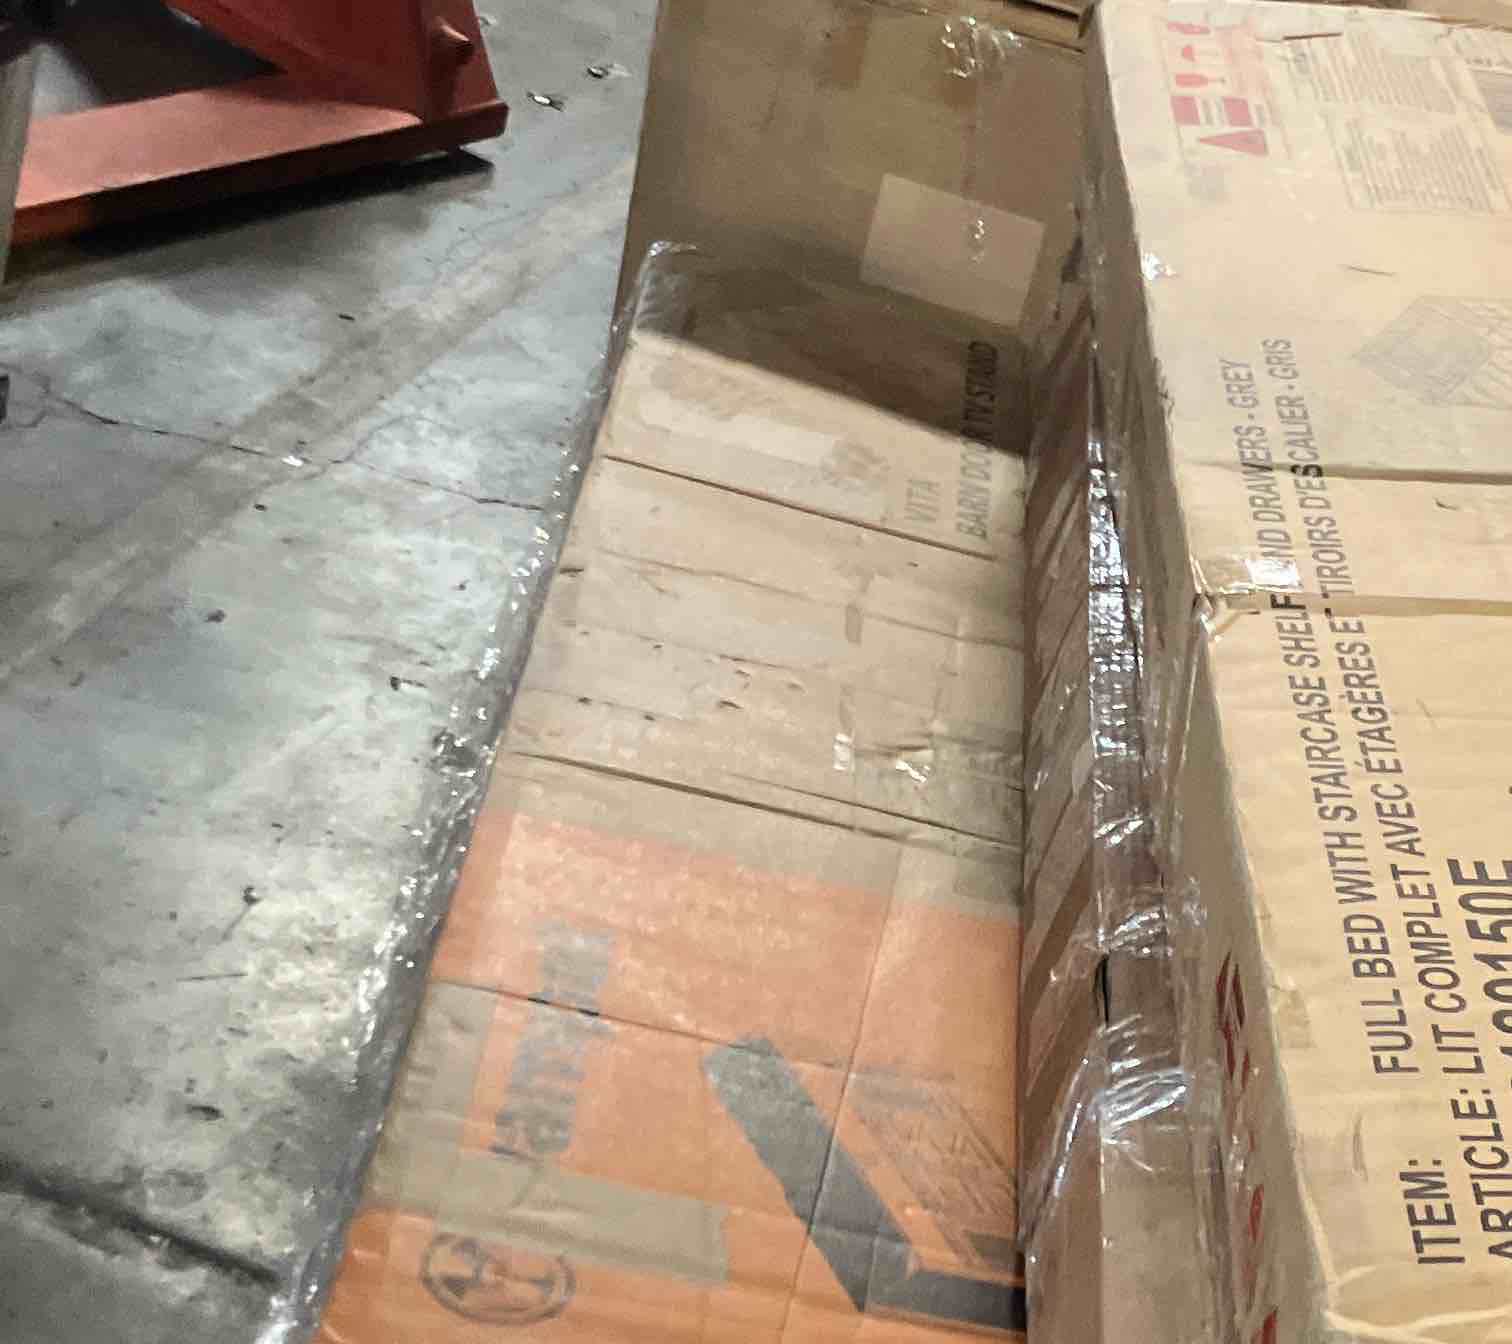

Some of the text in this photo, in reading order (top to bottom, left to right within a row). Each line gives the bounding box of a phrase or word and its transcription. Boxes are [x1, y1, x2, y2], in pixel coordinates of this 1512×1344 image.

[1223, 359, 1260, 408] GREY
[1265, 339, 1300, 379] GRIS
[955, 339, 999, 542] BARN DOOR TV STAND
[1237, 426, 1286, 521] DRAWERS
[1279, 397, 1331, 508] D'ESCALIER
[903, 478, 941, 524] VITA
[1307, 516, 1353, 598] TIROIRS
[1272, 593, 1320, 666] SHELF
[1292, 676, 1357, 820] STAIRCASE
[1339, 642, 1402, 773] ÉTAGÈRES
[1374, 783, 1425, 855] AVEC
[1327, 832, 1377, 903] WITH
[1346, 914, 1396, 977] BED
[1394, 865, 1466, 1012] COMPLET
[1365, 989, 1419, 1072] FULL
[1434, 1024, 1485, 1073] LIT
[1403, 1160, 1465, 1263] ITEM:
